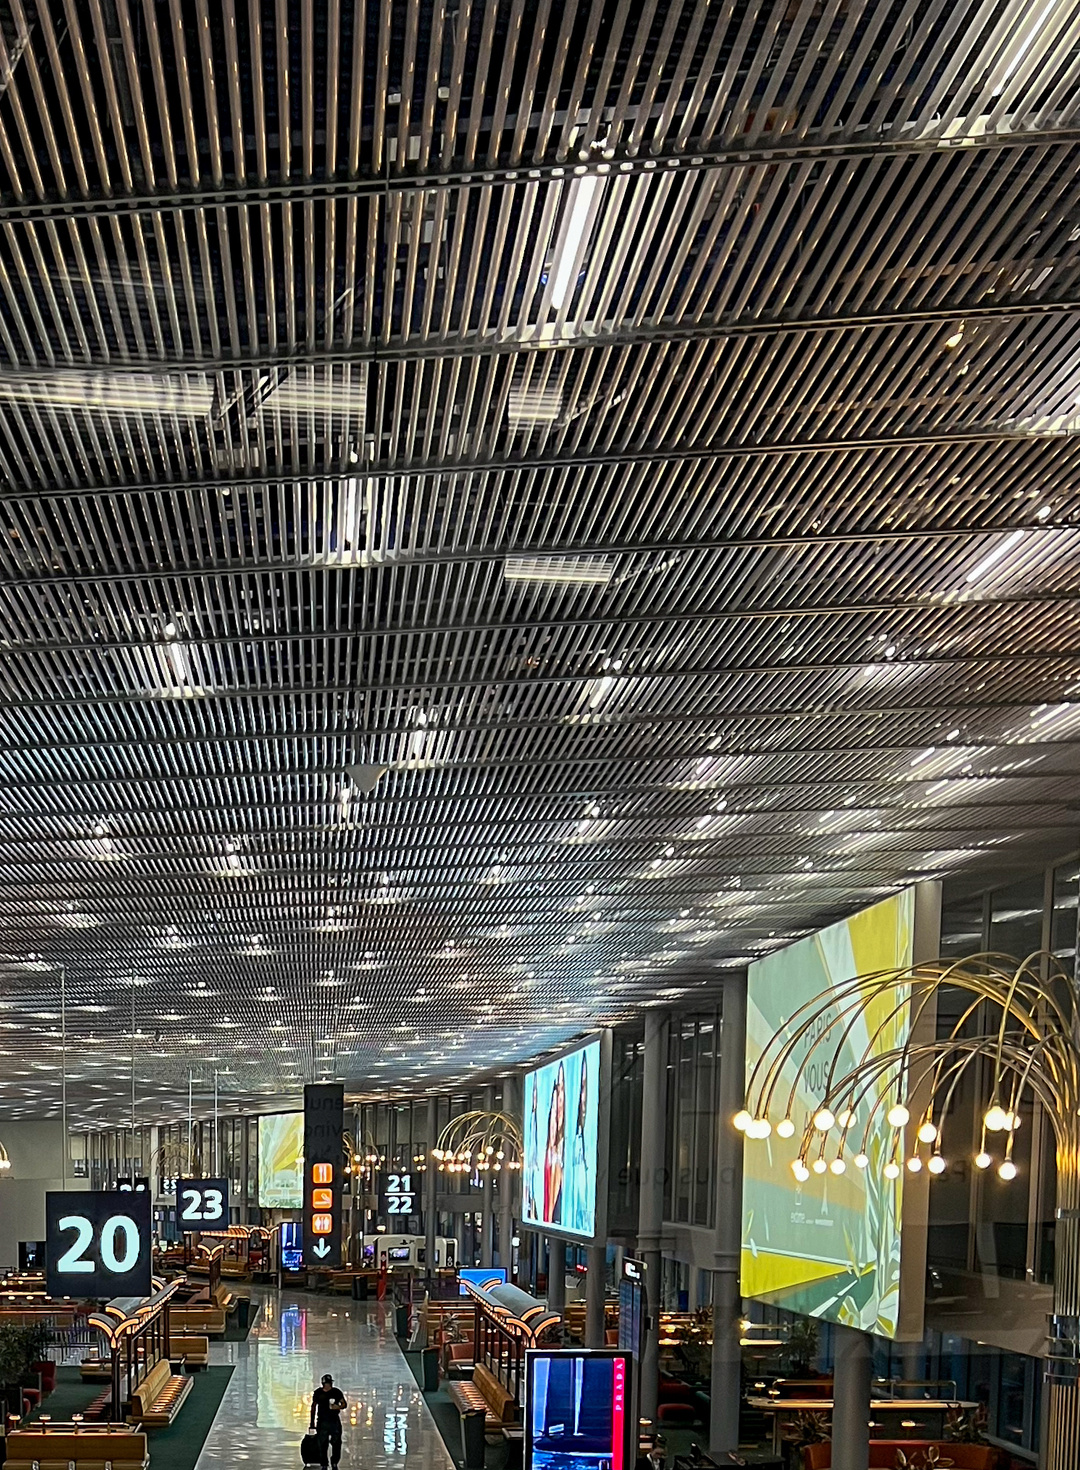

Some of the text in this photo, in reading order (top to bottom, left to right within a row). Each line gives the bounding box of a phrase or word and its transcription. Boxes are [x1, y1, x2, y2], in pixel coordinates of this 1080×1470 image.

[804, 1060, 831, 1094] VOUS
[387, 1174, 411, 1193] 21
[181, 1189, 223, 1220] 23
[387, 1196, 413, 1214] 22
[58, 1215, 140, 1273] 20
[615, 1363, 623, 1411] PRADA
